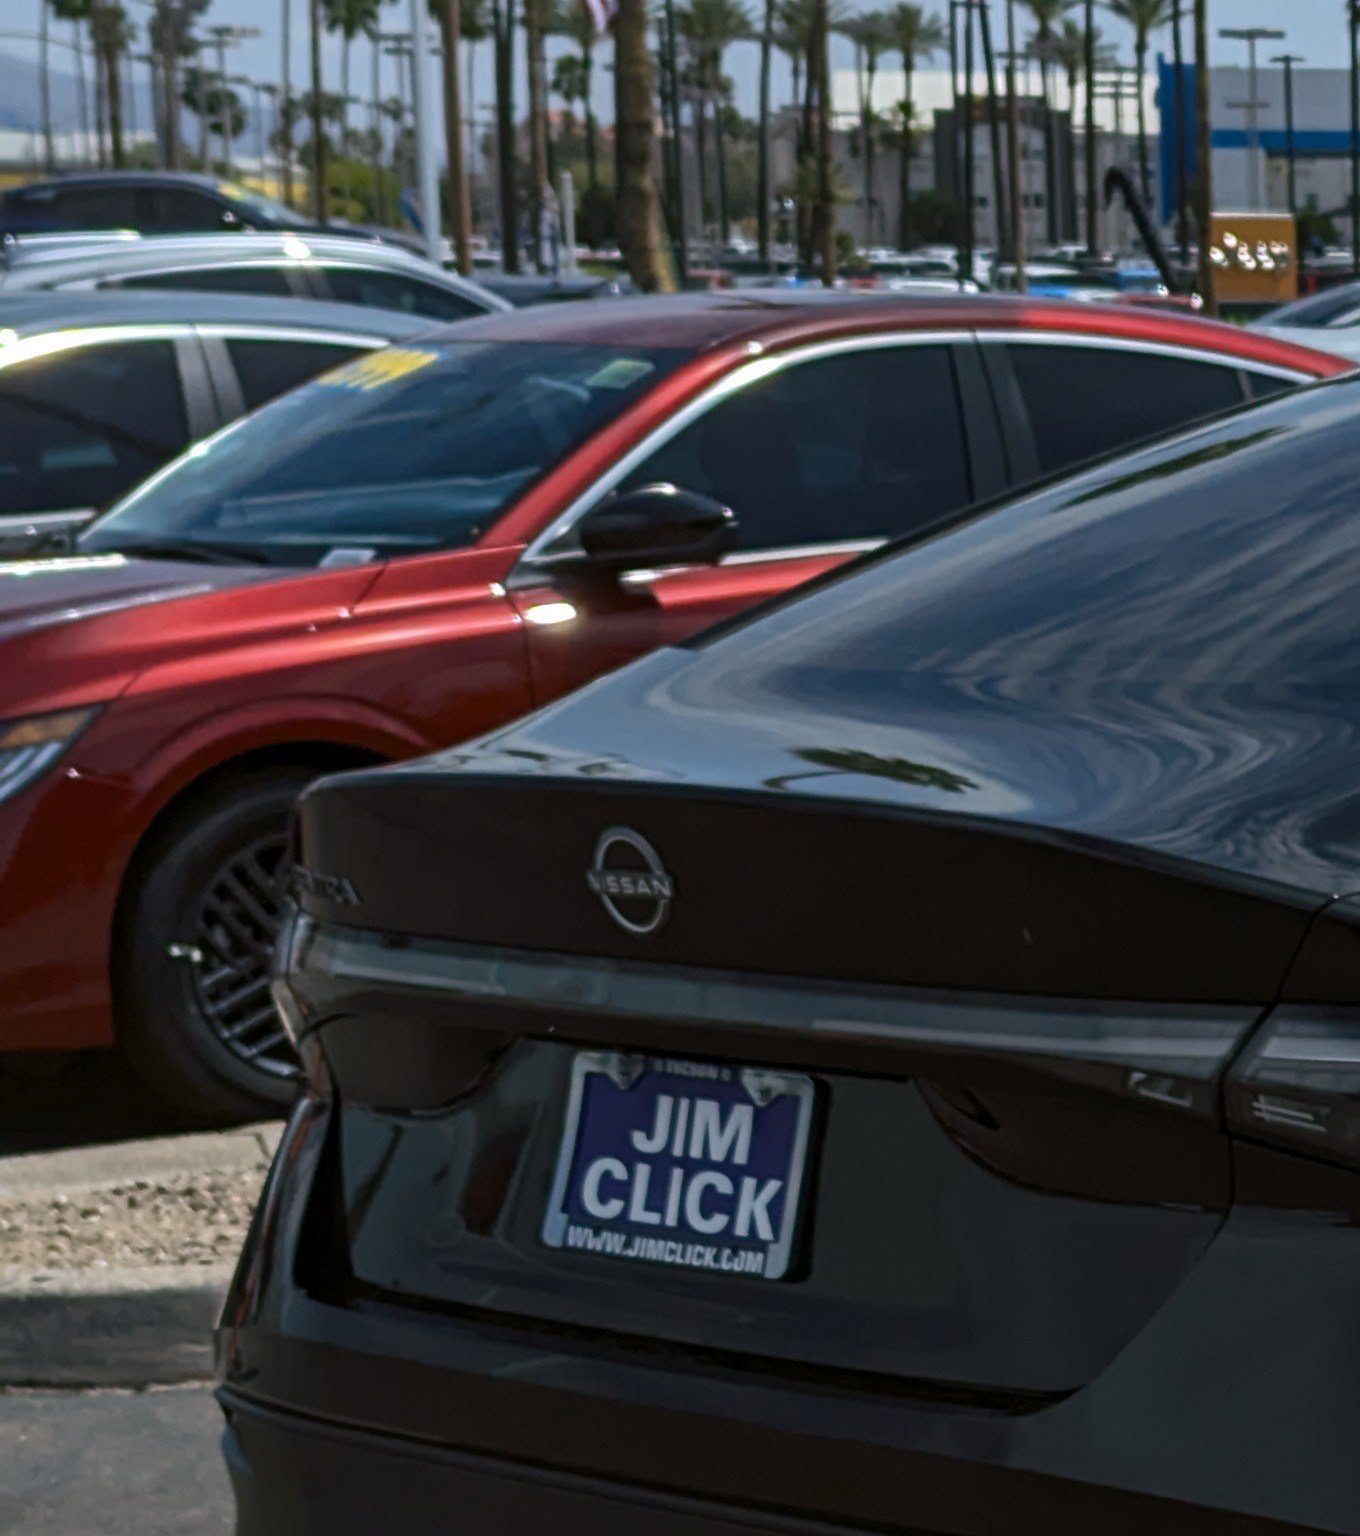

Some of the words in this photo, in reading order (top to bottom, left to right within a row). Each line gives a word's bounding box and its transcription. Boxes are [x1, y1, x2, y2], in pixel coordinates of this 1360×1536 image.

[630, 1094, 754, 1165] JIM
[582, 1157, 784, 1241] CLICK
[567, 1225, 765, 1274] WWW.JIMCLICK.COM
